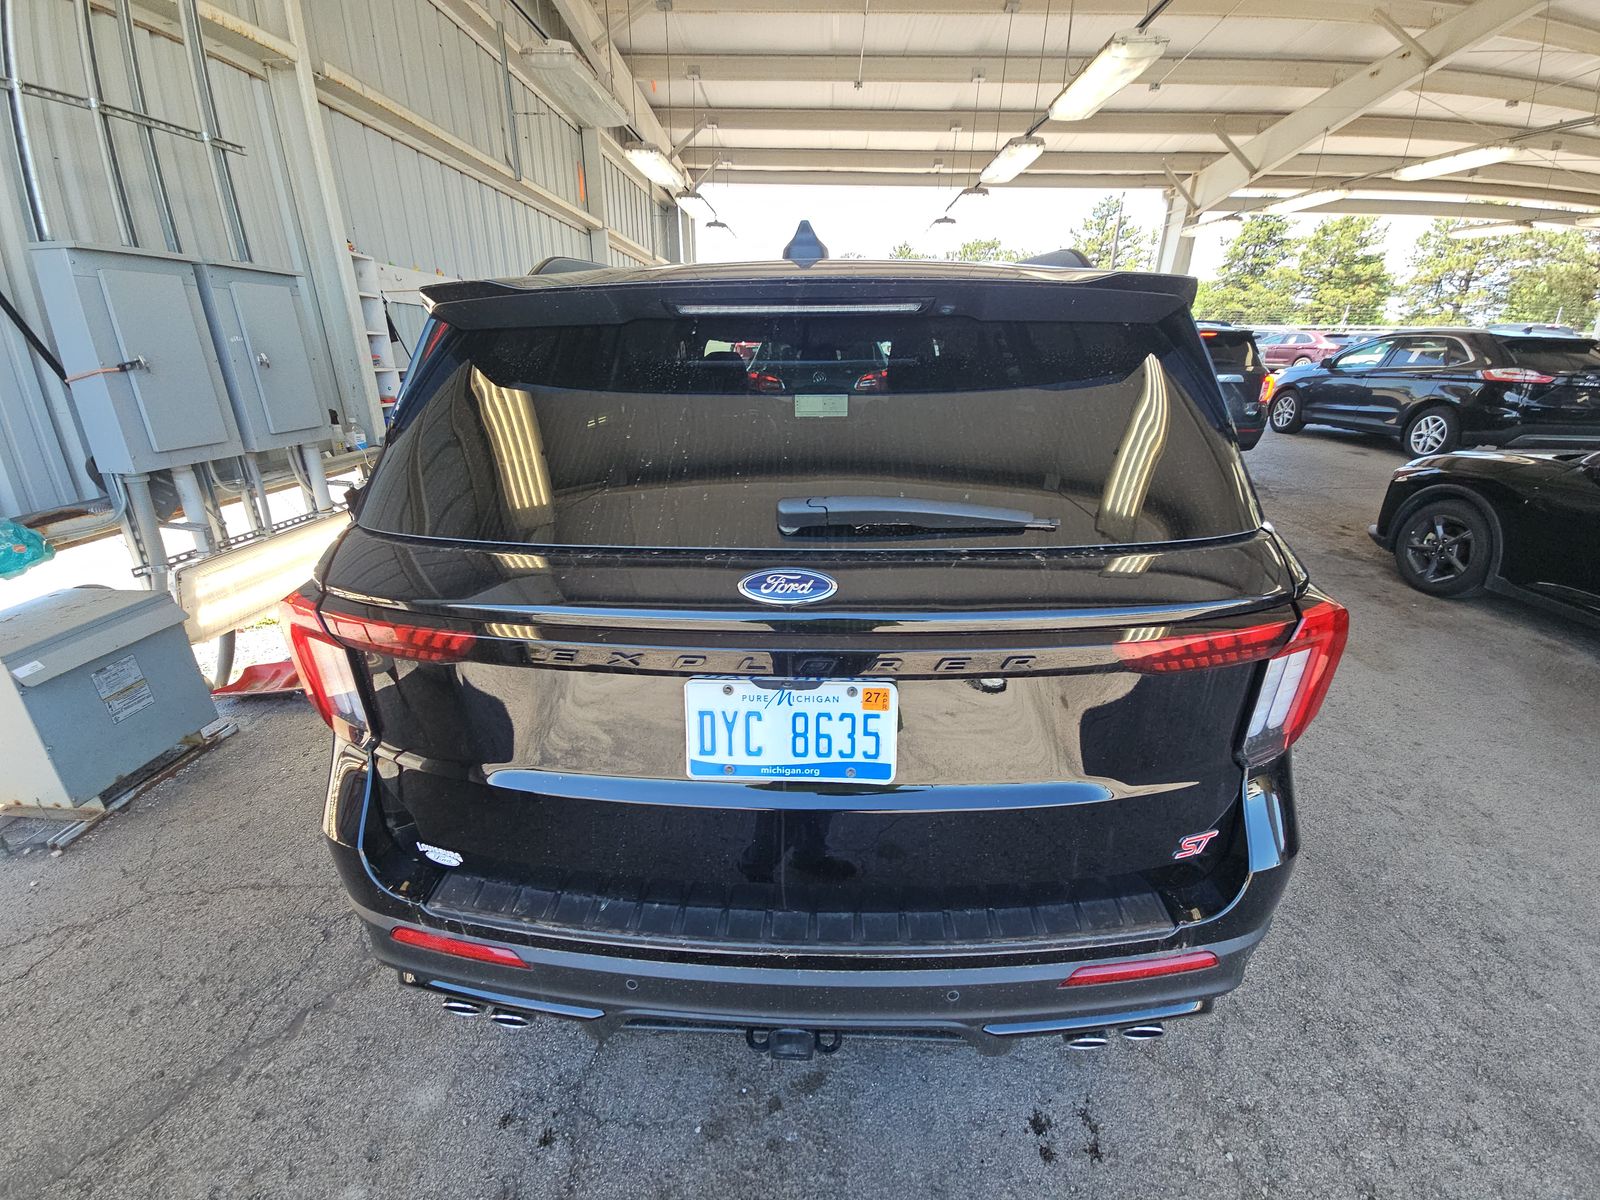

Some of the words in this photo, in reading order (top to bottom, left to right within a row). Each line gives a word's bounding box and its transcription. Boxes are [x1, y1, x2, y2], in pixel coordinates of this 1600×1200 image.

[760, 574, 815, 594] Ford
[546, 647, 1037, 674] EXPLORER
[741, 694, 769, 702] PURE
[764, 688, 840, 710] MICHIGAN
[865, 691, 881, 703] 27
[697, 710, 763, 757] DYC
[791, 711, 880, 760] 8635
[760, 766, 820, 777] michigan.org
[1175, 830, 1219, 859] ST
